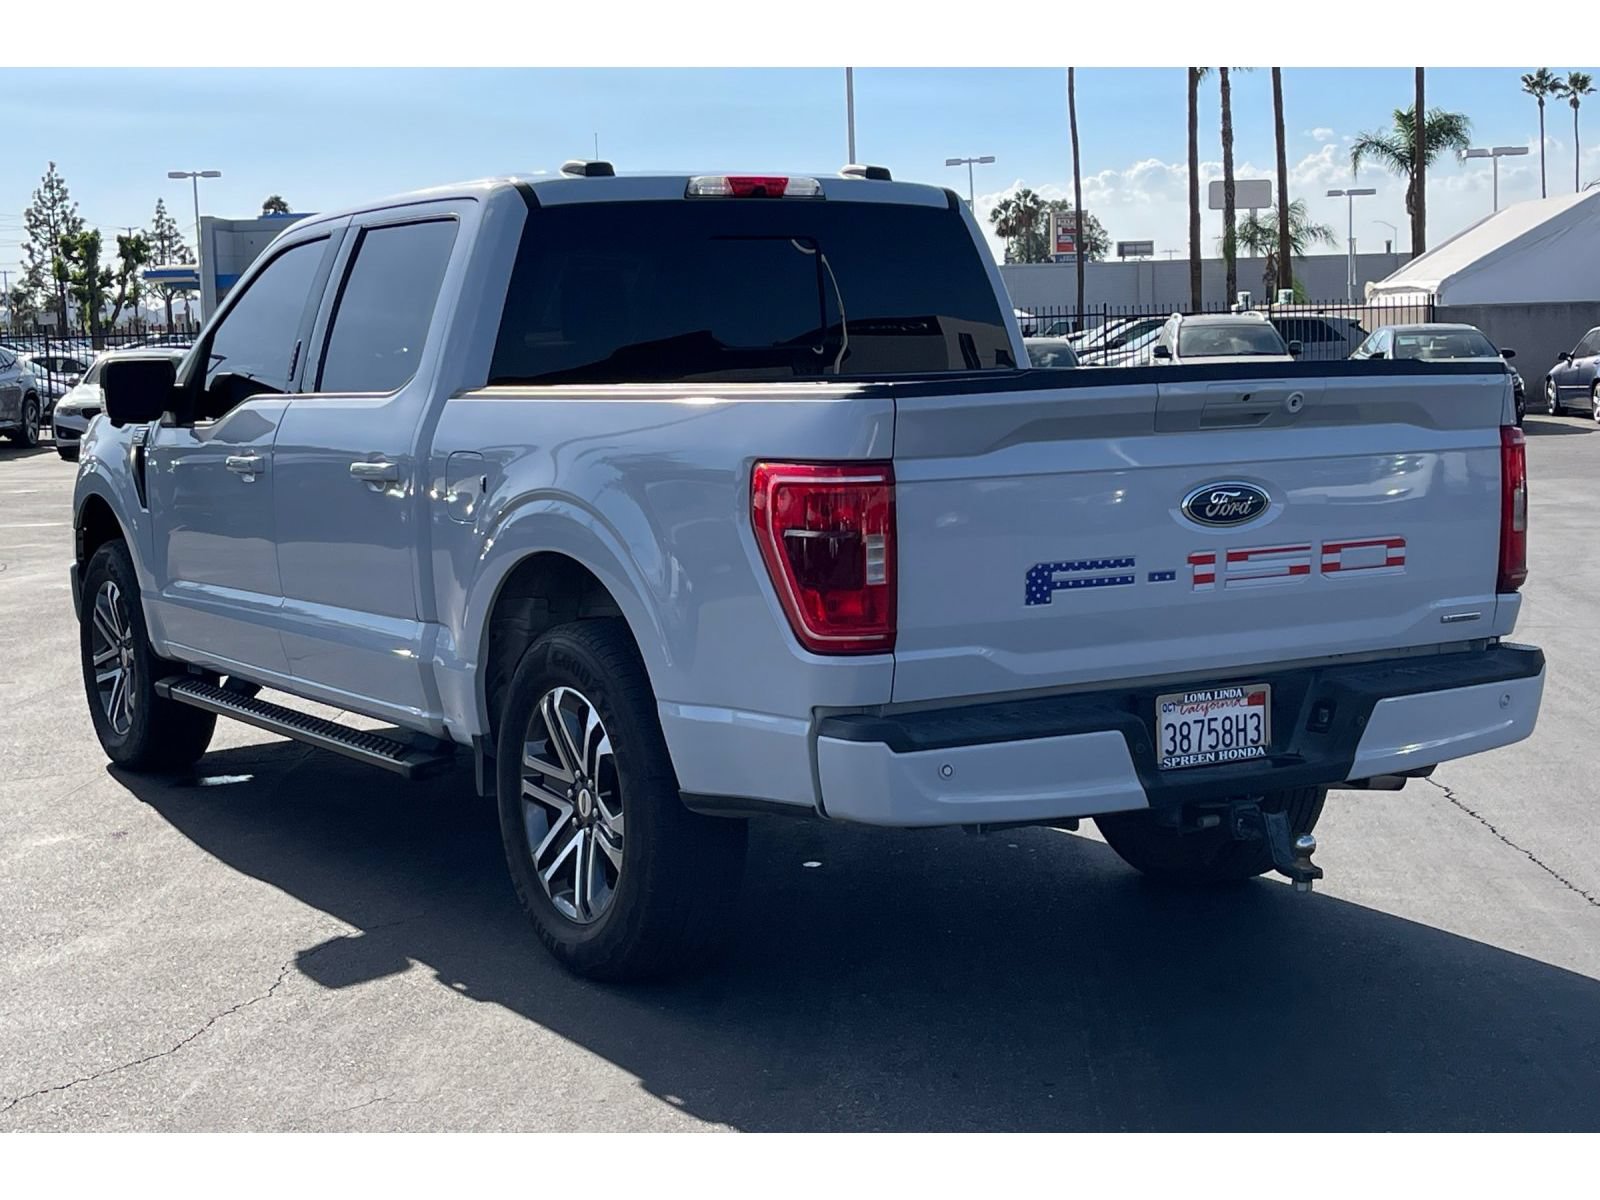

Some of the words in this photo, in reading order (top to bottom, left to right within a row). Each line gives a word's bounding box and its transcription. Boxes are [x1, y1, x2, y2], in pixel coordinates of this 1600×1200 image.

[1205, 491, 1254, 517] Ford
[1025, 536, 1407, 606] F-150
[1184, 692, 1212, 703] LOMA
[1214, 688, 1243, 700] LINDA
[1162, 703, 1177, 713] OCT
[1180, 699, 1242, 717] California
[1164, 712, 1261, 755] 38758H3
[1163, 751, 1215, 768] SPREEN
[1219, 746, 1266, 760] HONDA
